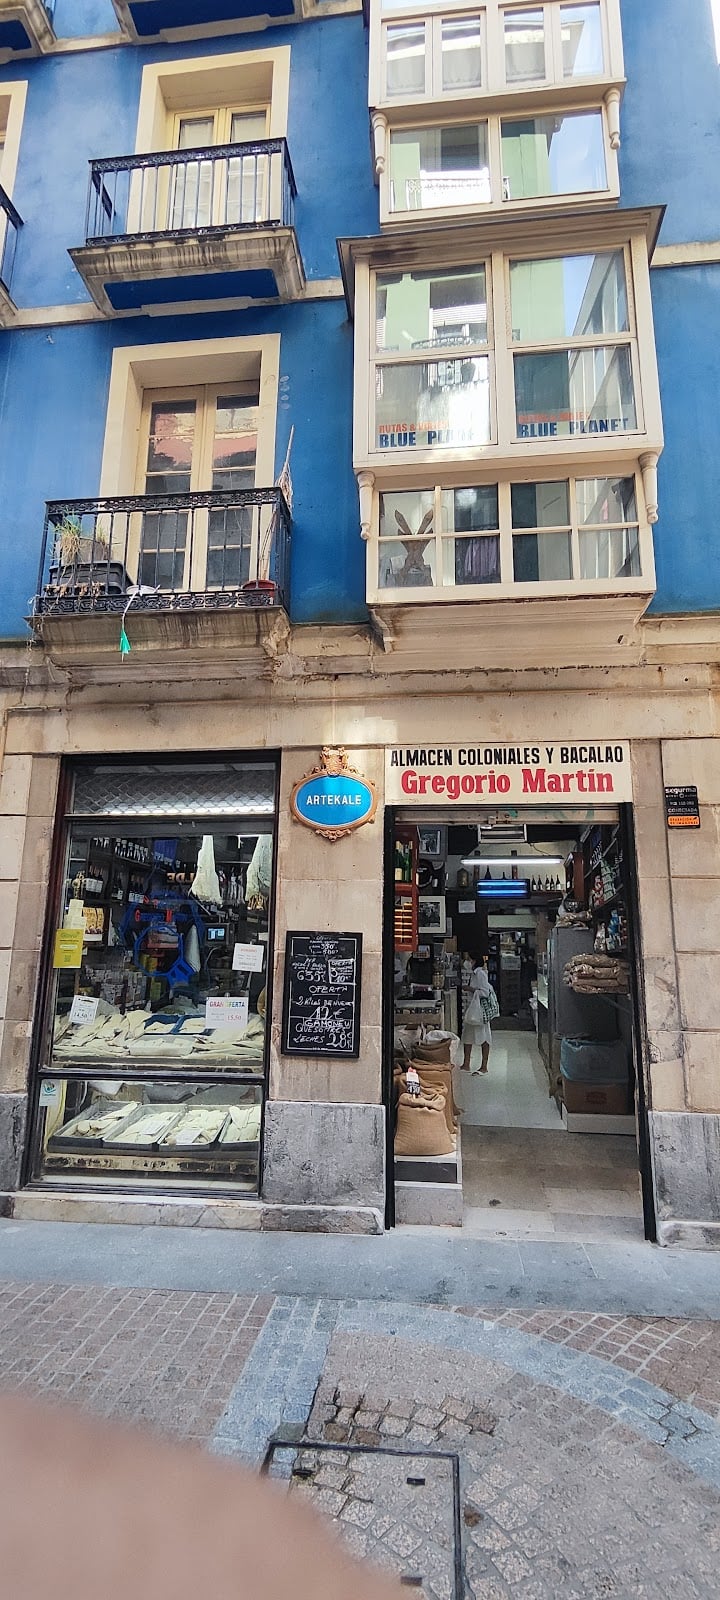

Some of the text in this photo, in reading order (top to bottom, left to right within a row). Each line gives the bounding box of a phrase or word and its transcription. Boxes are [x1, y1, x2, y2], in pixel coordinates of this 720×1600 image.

[378, 423, 407, 433] RUTAS
[409, 423, 416, 431] &
[516, 418, 629, 438] BLUE PLANET
[378, 431, 417, 448] BLUE
[390, 746, 624, 767] ALMACEN COLONIALES Y BACALAO
[401, 768, 614, 800] Gregorio Martín
[306, 794, 362, 806] ARTEKALE
[308, 985, 348, 994] OFERTA
